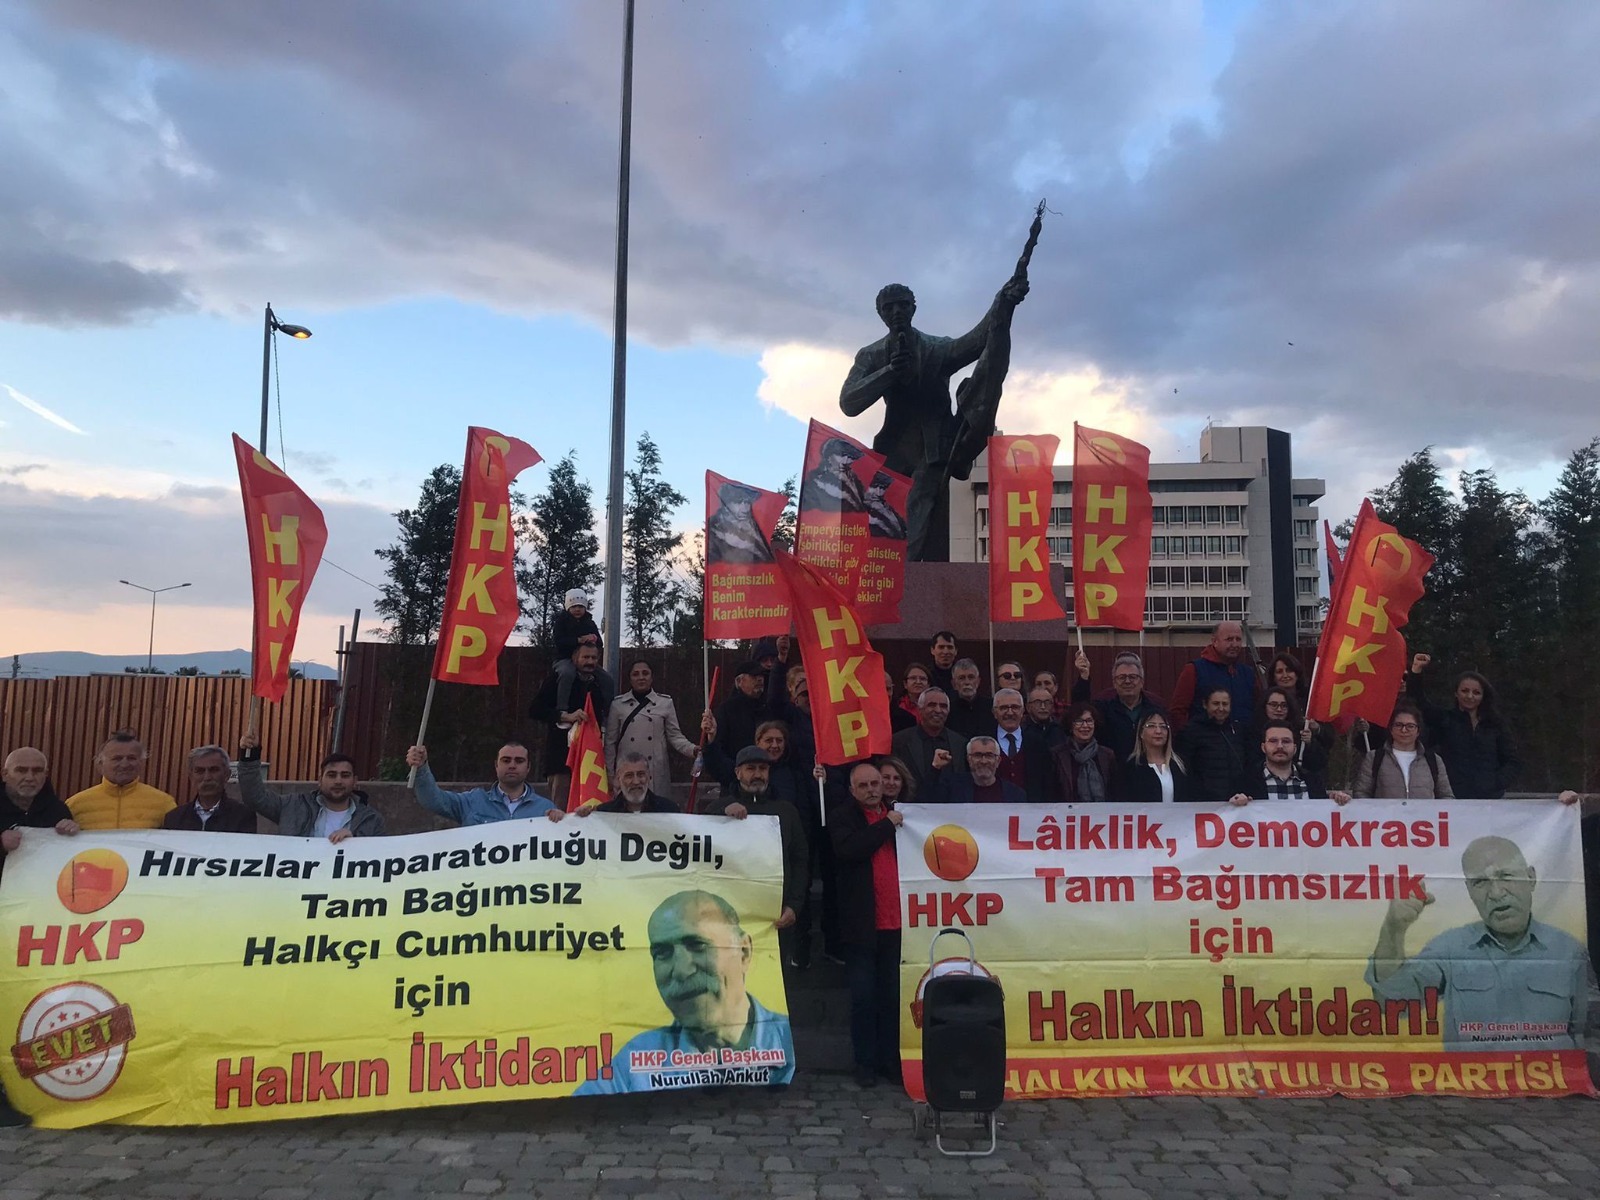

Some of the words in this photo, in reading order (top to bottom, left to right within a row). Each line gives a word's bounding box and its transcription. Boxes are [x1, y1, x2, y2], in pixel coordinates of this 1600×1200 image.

[799, 523, 868, 538] Emperyalistler,
[1082, 484, 1128, 619] HKP
[844, 557, 859, 571] gibi
[1007, 490, 1043, 617] HKP
[446, 502, 508, 674] HKP
[712, 572, 776, 589] Bağımsızlık
[712, 592, 746, 604] Benim
[876, 578, 895, 590] gibi
[712, 605, 789, 621] Karakterimdir
[1329, 585, 1389, 717] HKP
[812, 605, 869, 758] HKP
[139, 849, 320, 880] Hırsızlar
[331, 831, 607, 883] İmparatorluğu
[619, 832, 724, 870] Değil,
[1008, 814, 1178, 857] Lâiklik,
[1195, 812, 1450, 849] Demokrasi
[301, 894, 388, 920] Tam
[402, 882, 582, 917] Bağımsız
[908, 892, 1004, 928] HKP
[1035, 867, 1135, 903] Tam
[1152, 864, 1428, 911] Bağımsızlık
[16, 918, 145, 967] HKP
[243, 934, 381, 970] Halkçı
[395, 923, 626, 960] Cumhuriyet
[1189, 917, 1274, 963] için
[394, 974, 471, 1018] için
[1028, 988, 1204, 1042] Halkın
[1221, 974, 1440, 1037] İktidarı!
[31, 1014, 115, 1068] EVET
[1460, 1022, 1484, 1032] HKP
[1487, 1022, 1519, 1032] Genel
[214, 1051, 390, 1110] Halkın
[408, 1031, 614, 1093] İktidarı!
[630, 1051, 667, 1067] HKP
[671, 1050, 717, 1065] Genel
[722, 1047, 785, 1065] Başkanı
[650, 1070, 721, 1088] Nurullah
[725, 1068, 770, 1084] Ankut
[1409, 1053, 1568, 1091] PARTİSİ
